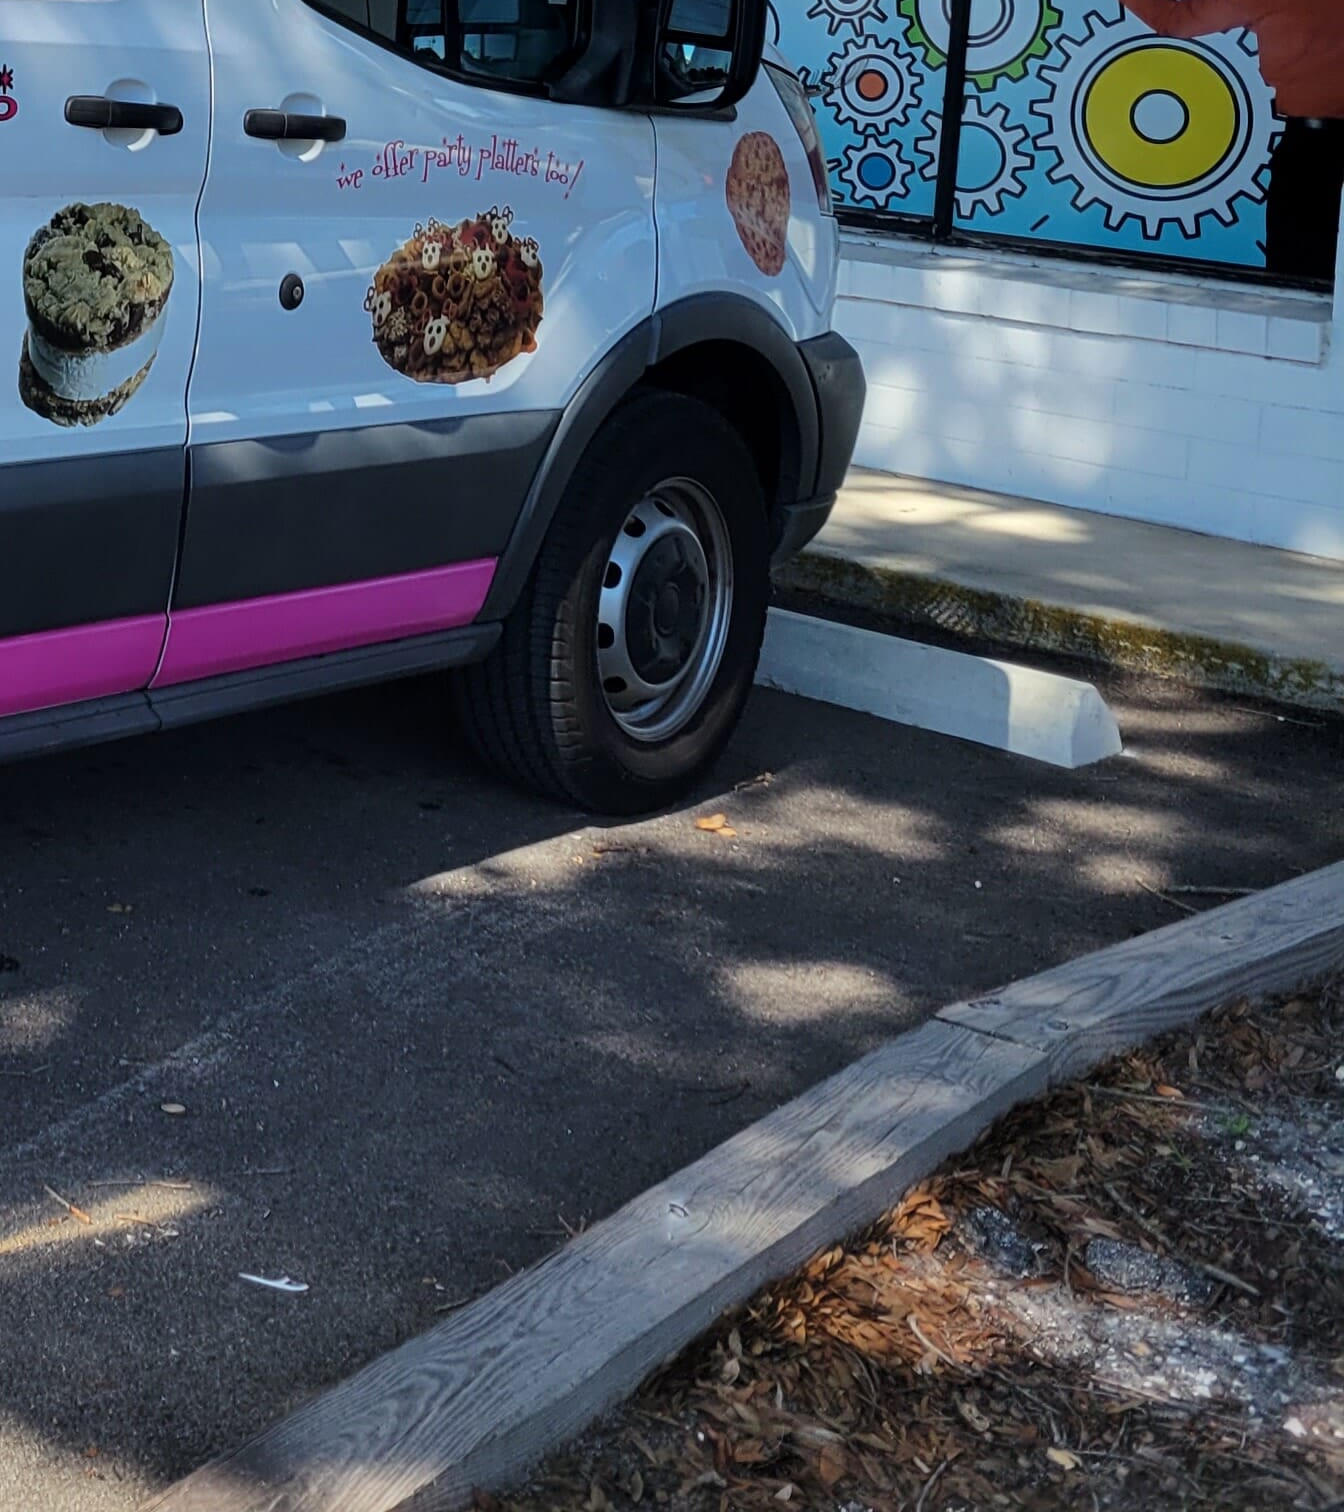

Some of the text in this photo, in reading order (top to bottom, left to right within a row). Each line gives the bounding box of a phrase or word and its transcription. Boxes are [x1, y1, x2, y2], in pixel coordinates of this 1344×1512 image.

[336, 162, 363, 189] we
[372, 140, 419, 180] offer
[421, 133, 472, 183] party
[545, 151, 584, 200] too!
